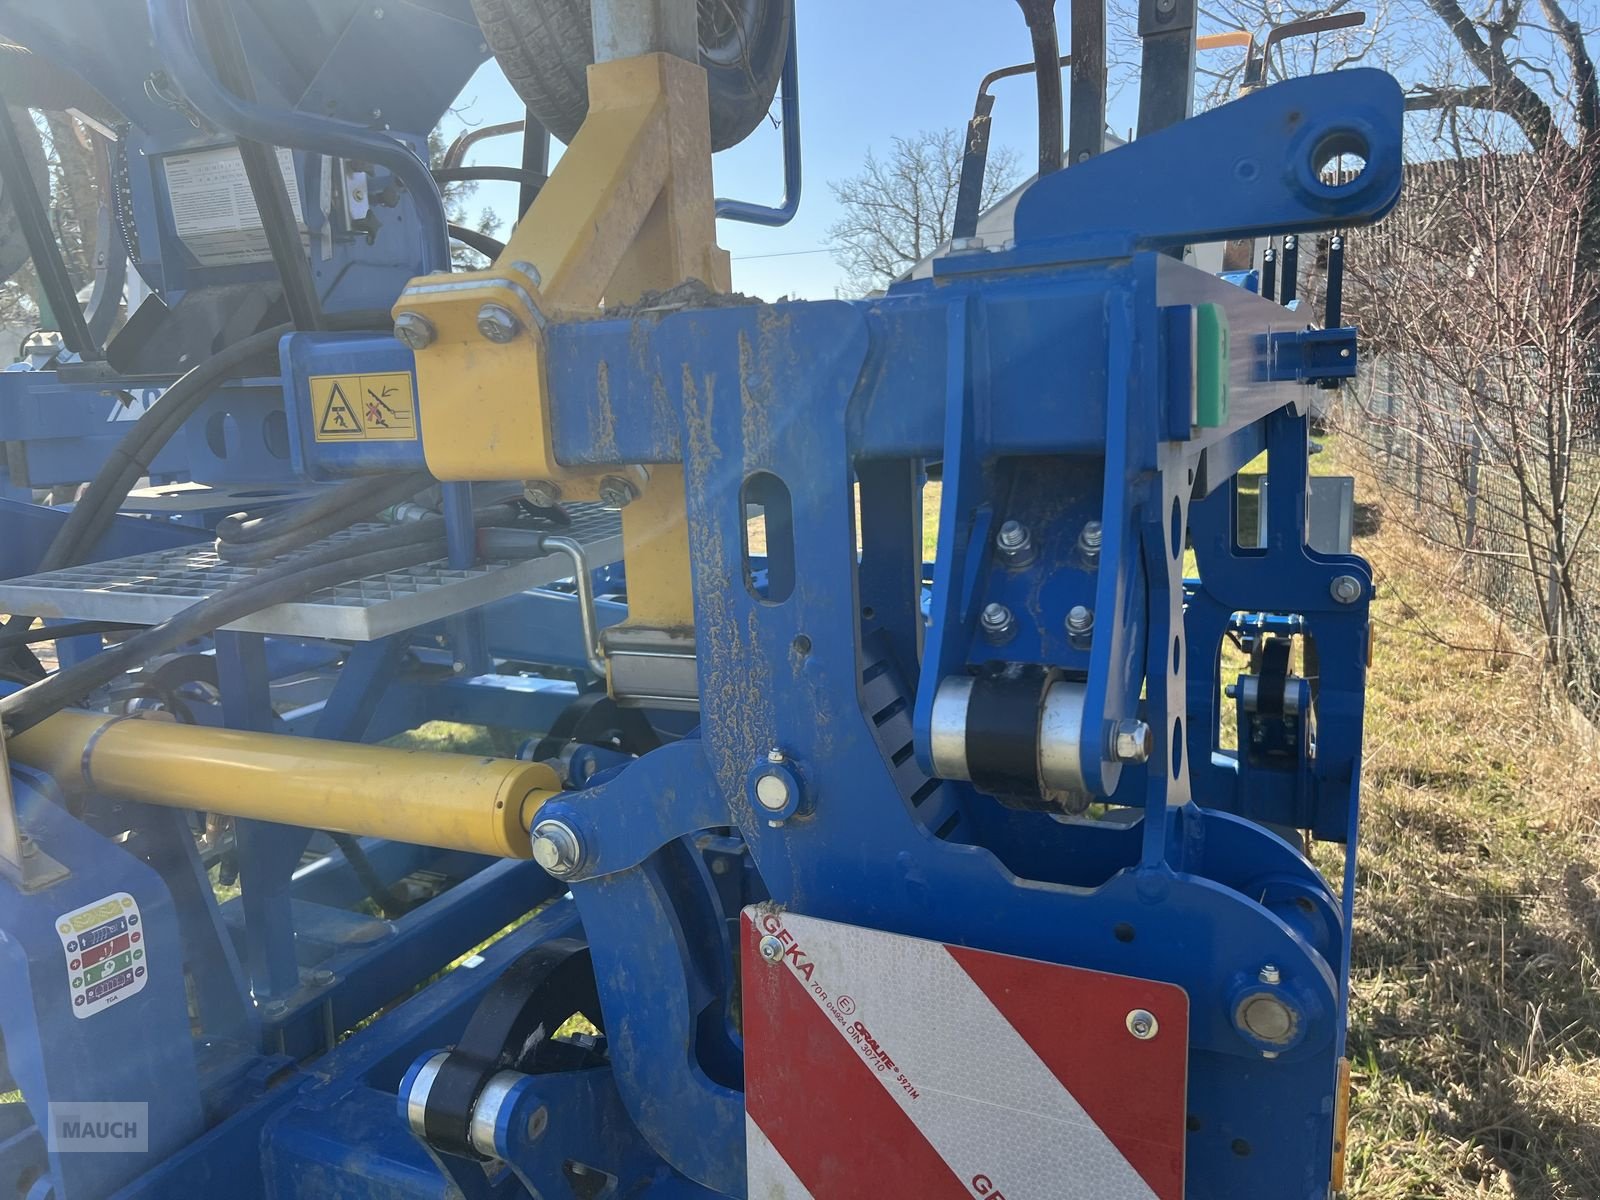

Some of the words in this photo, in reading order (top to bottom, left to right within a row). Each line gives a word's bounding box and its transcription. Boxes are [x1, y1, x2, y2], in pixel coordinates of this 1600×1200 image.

[763, 914, 815, 982] GEKA
[811, 981, 828, 1001] 70R
[846, 1025, 863, 1044] DIN
[860, 1044, 885, 1072] 30710
[897, 1074, 920, 1100] 5921M
